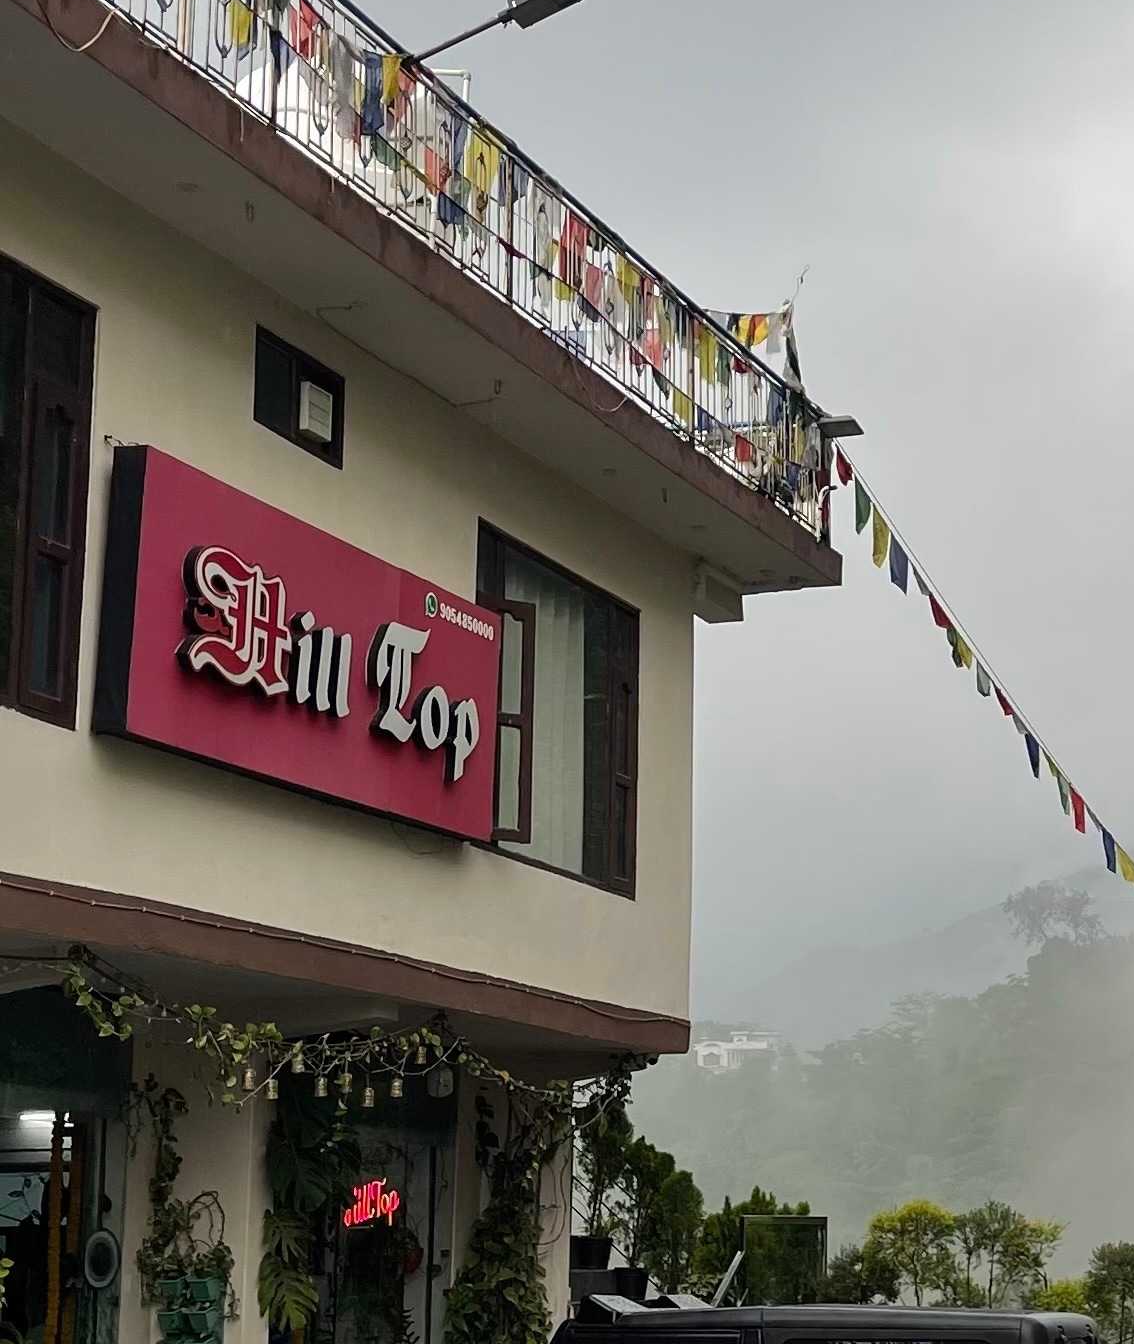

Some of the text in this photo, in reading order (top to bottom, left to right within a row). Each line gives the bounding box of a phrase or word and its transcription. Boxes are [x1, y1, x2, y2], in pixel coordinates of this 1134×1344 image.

[176, 545, 479, 782] Hill Top
[371, 1177, 400, 1226] Top
